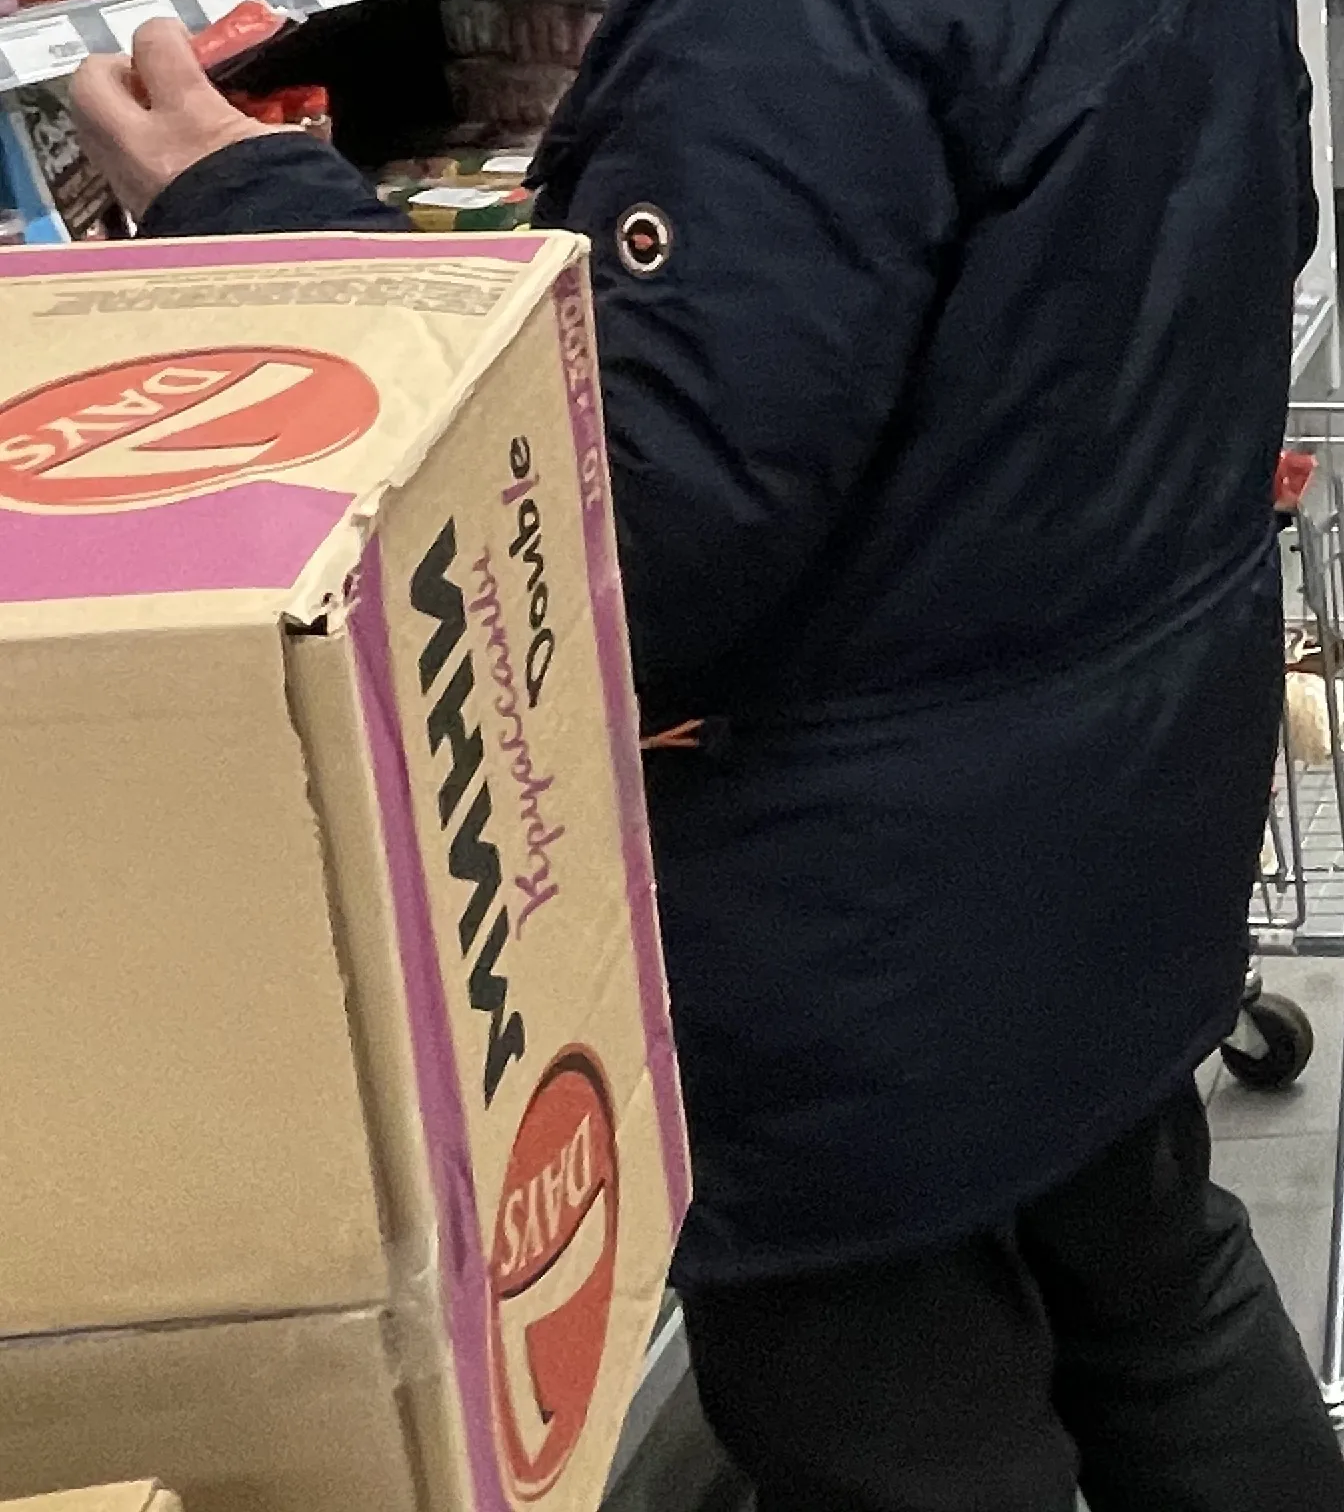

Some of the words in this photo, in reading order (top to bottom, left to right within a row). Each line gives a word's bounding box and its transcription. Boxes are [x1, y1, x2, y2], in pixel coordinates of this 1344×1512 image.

[0, 365, 231, 473] DAYS
[34, 361, 315, 480] 7
[502, 435, 555, 708] Double
[411, 515, 526, 1111] МИНИ
[467, 546, 566, 940] Круассаны
[499, 1181, 605, 1466] 7
[500, 1114, 592, 1275] DAYS
